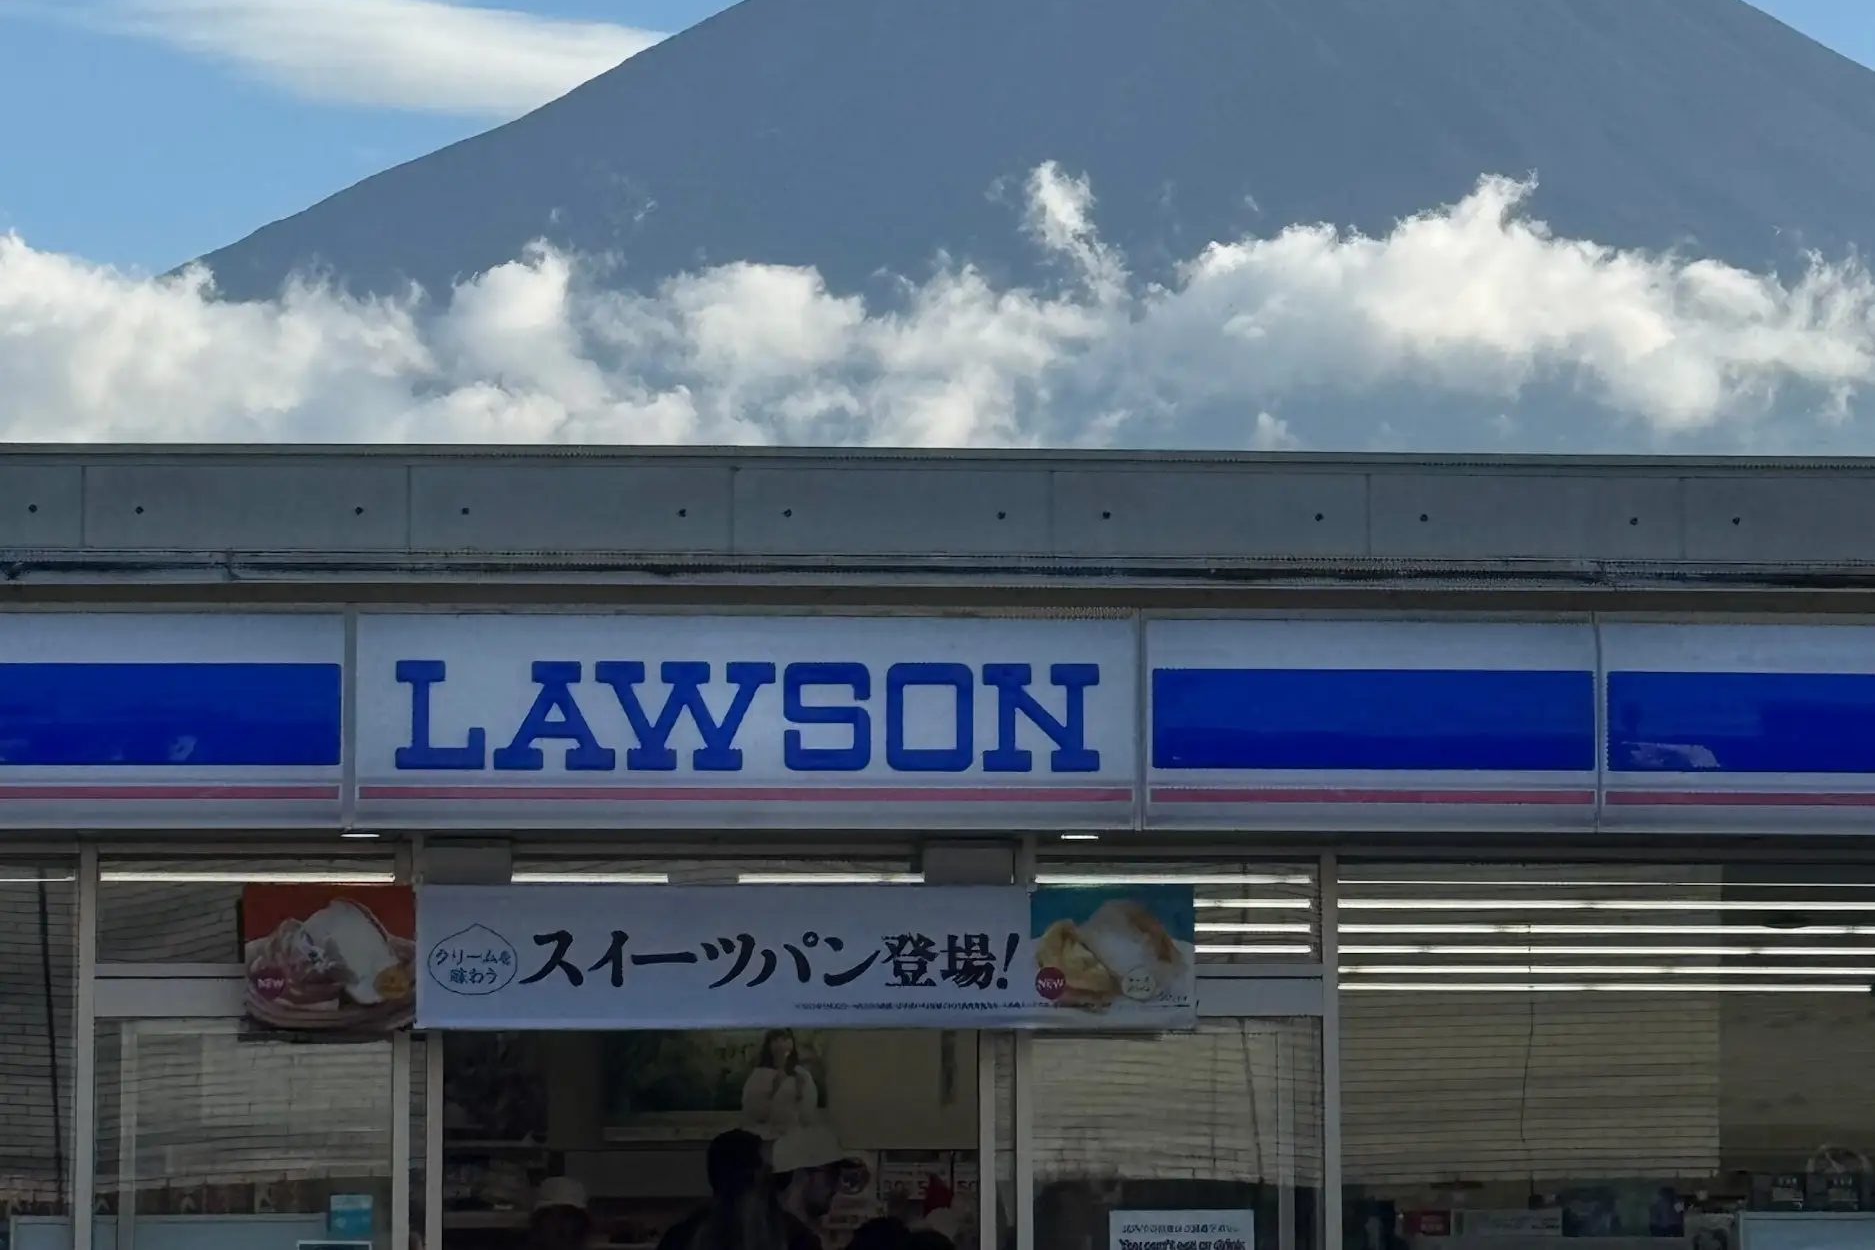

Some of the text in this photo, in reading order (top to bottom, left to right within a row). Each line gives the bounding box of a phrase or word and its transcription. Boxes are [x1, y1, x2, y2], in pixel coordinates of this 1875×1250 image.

[395, 660, 1101, 772] LAWSON
[257, 977, 285, 990] NEW
[1037, 977, 1065, 991] NEW
